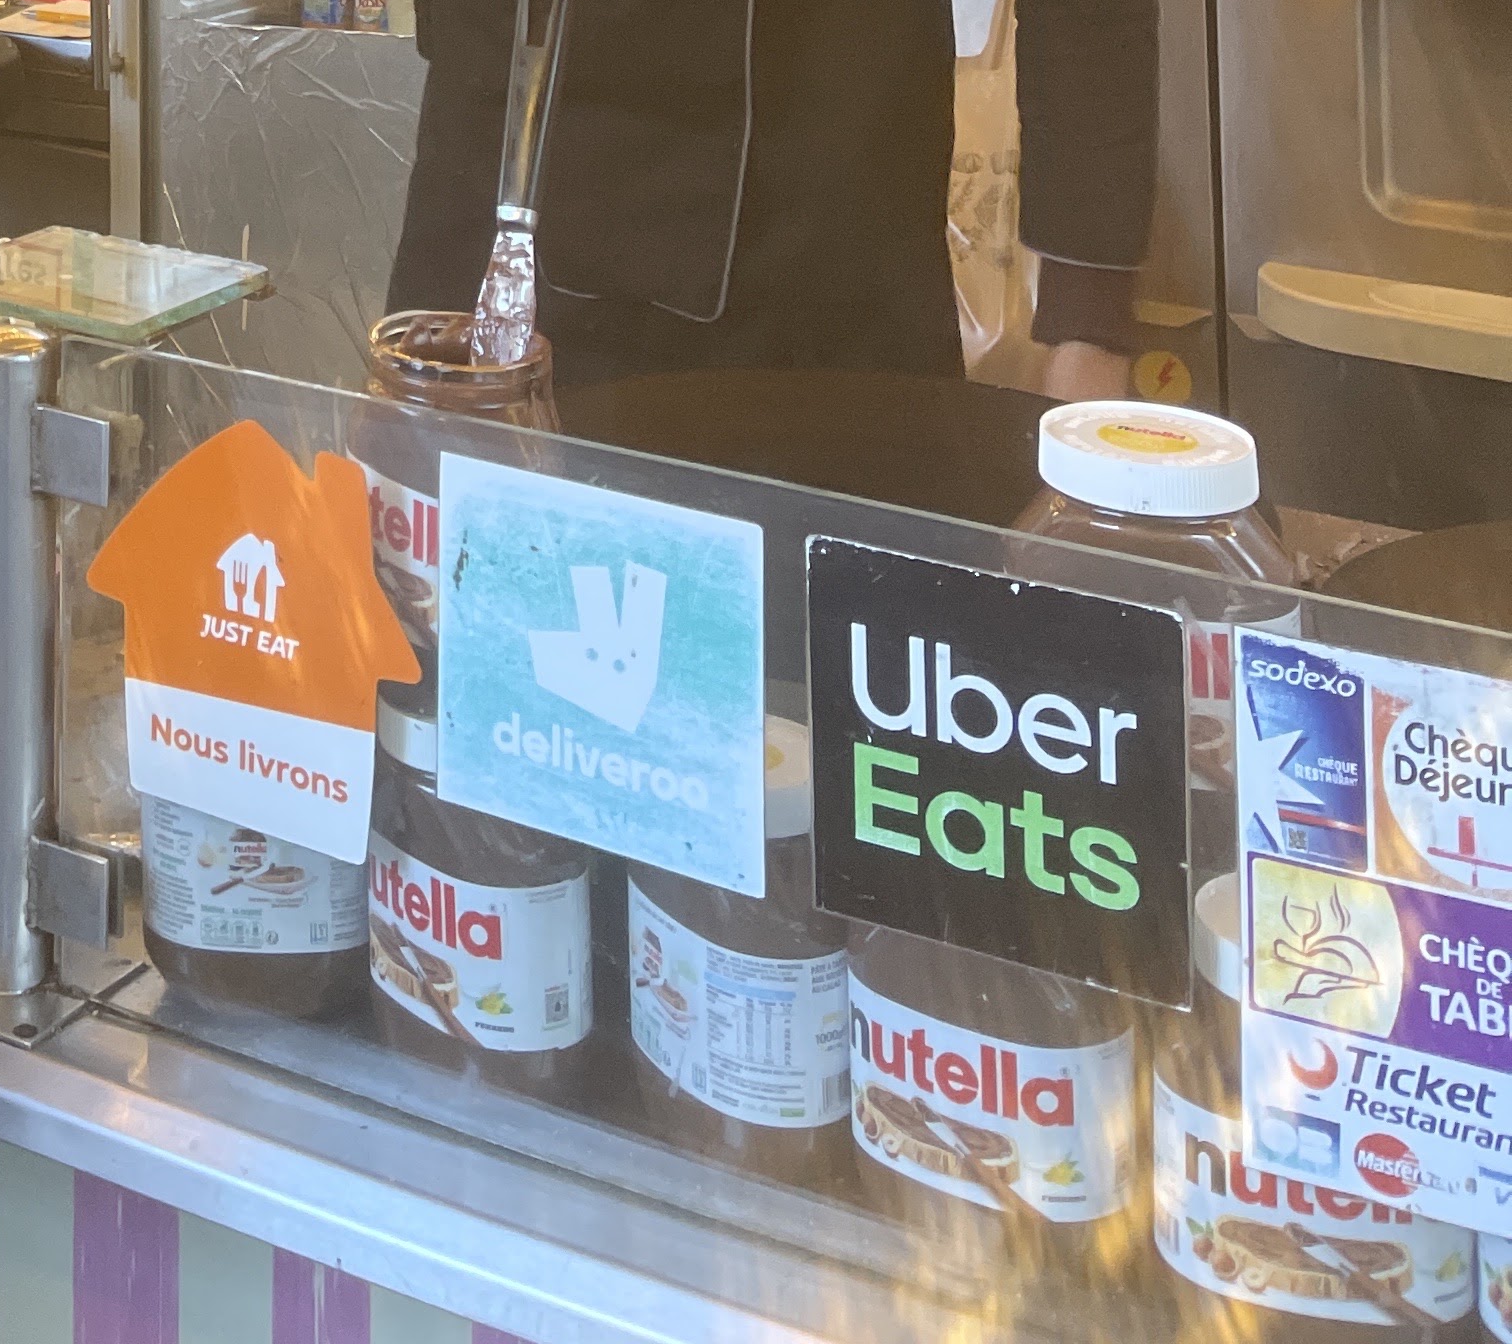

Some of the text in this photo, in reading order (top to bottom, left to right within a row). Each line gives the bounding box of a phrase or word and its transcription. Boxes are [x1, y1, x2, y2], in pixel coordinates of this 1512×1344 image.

[200, 613, 300, 661] JUST EAT
[1249, 657, 1357, 699] sodexo
[851, 622, 1138, 786] Uber
[150, 713, 348, 804] Nous livrons
[493, 712, 709, 812] deliveroo
[853, 742, 1141, 912] Eats
[1476, 976, 1503, 1000] DE
[851, 1006, 1074, 1128] nutella
[1344, 1045, 1496, 1121] Ticket
